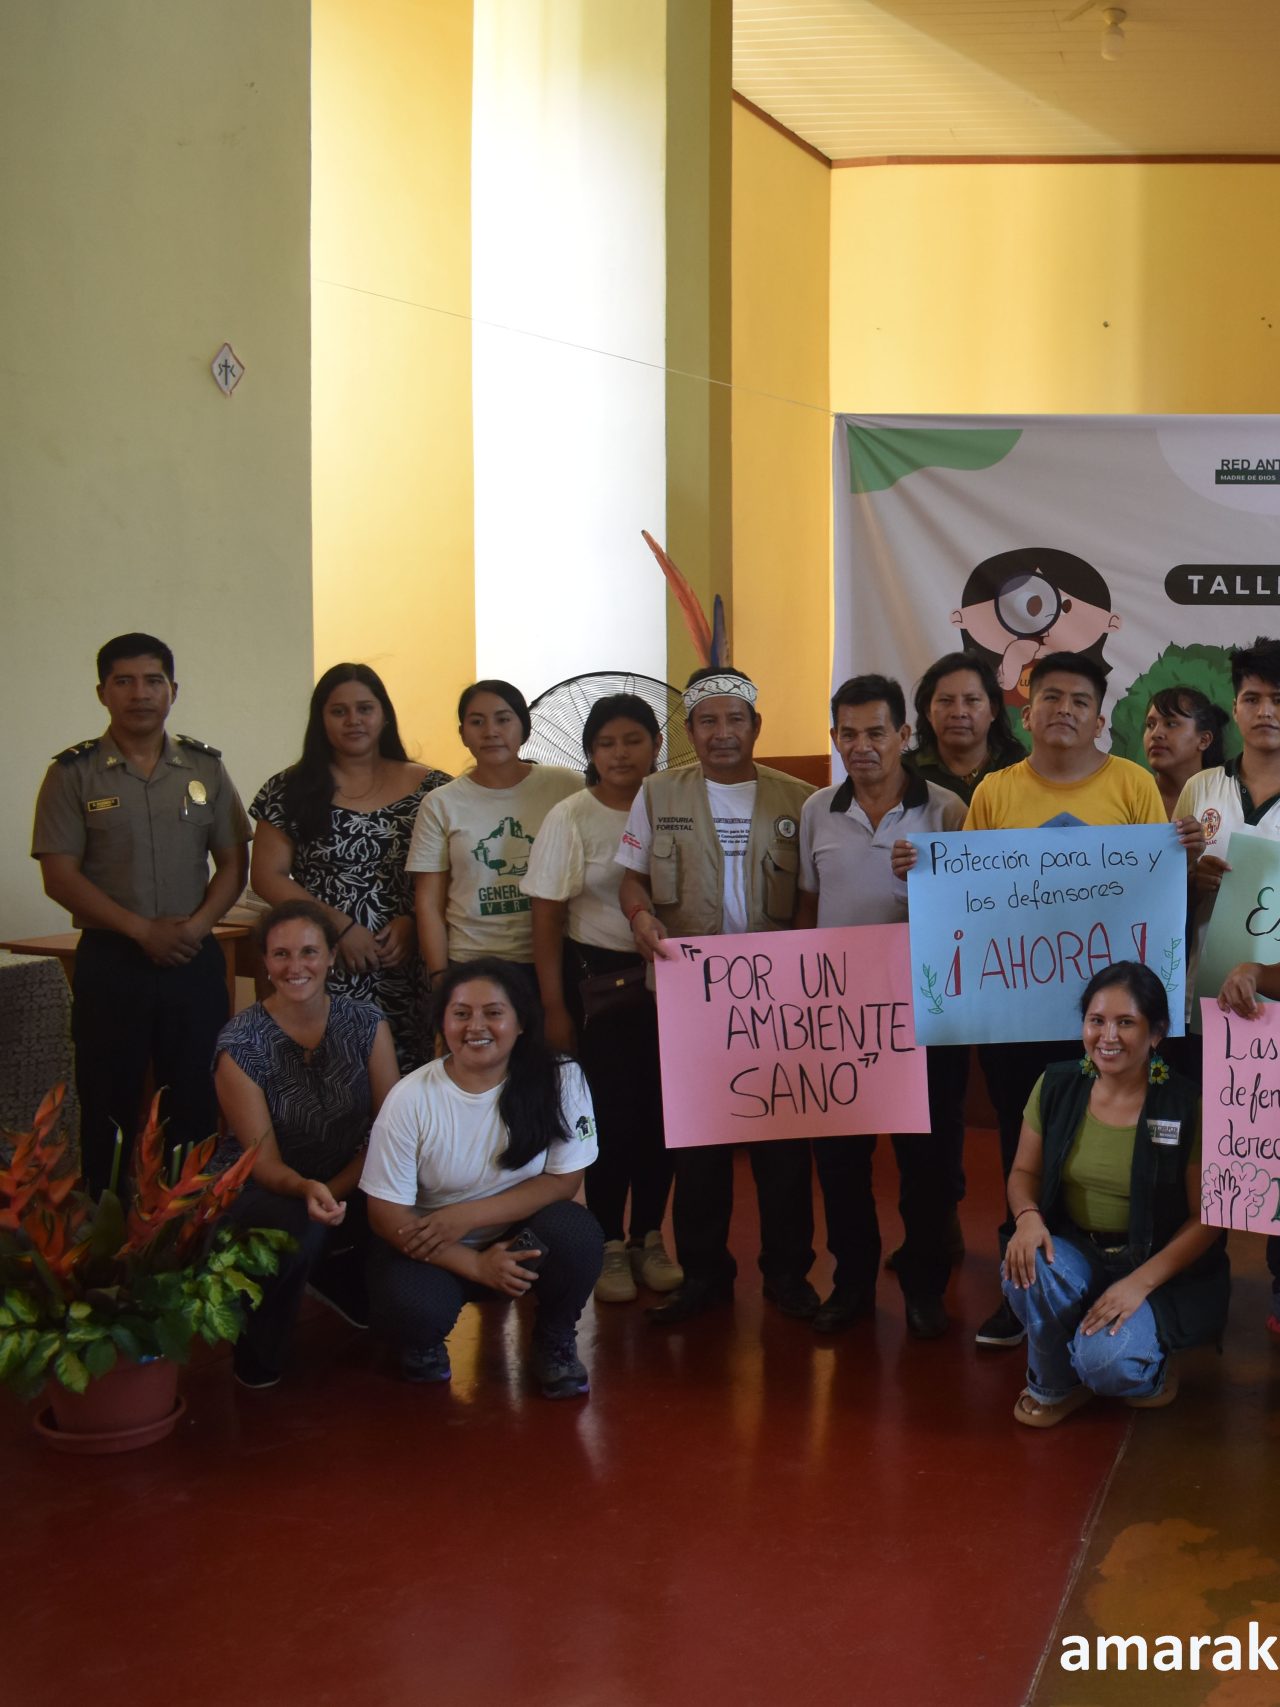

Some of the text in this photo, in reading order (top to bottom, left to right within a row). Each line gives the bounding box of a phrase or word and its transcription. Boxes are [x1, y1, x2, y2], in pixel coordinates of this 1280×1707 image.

[1221, 459, 1250, 471] RED
[930, 841, 1162, 875] Protección para las y
[965, 880, 1124, 913] los defensores
[801, 952, 846, 998] UN
[727, 1002, 916, 1052] AMBIENTE
[1224, 1016, 1278, 1060] Las
